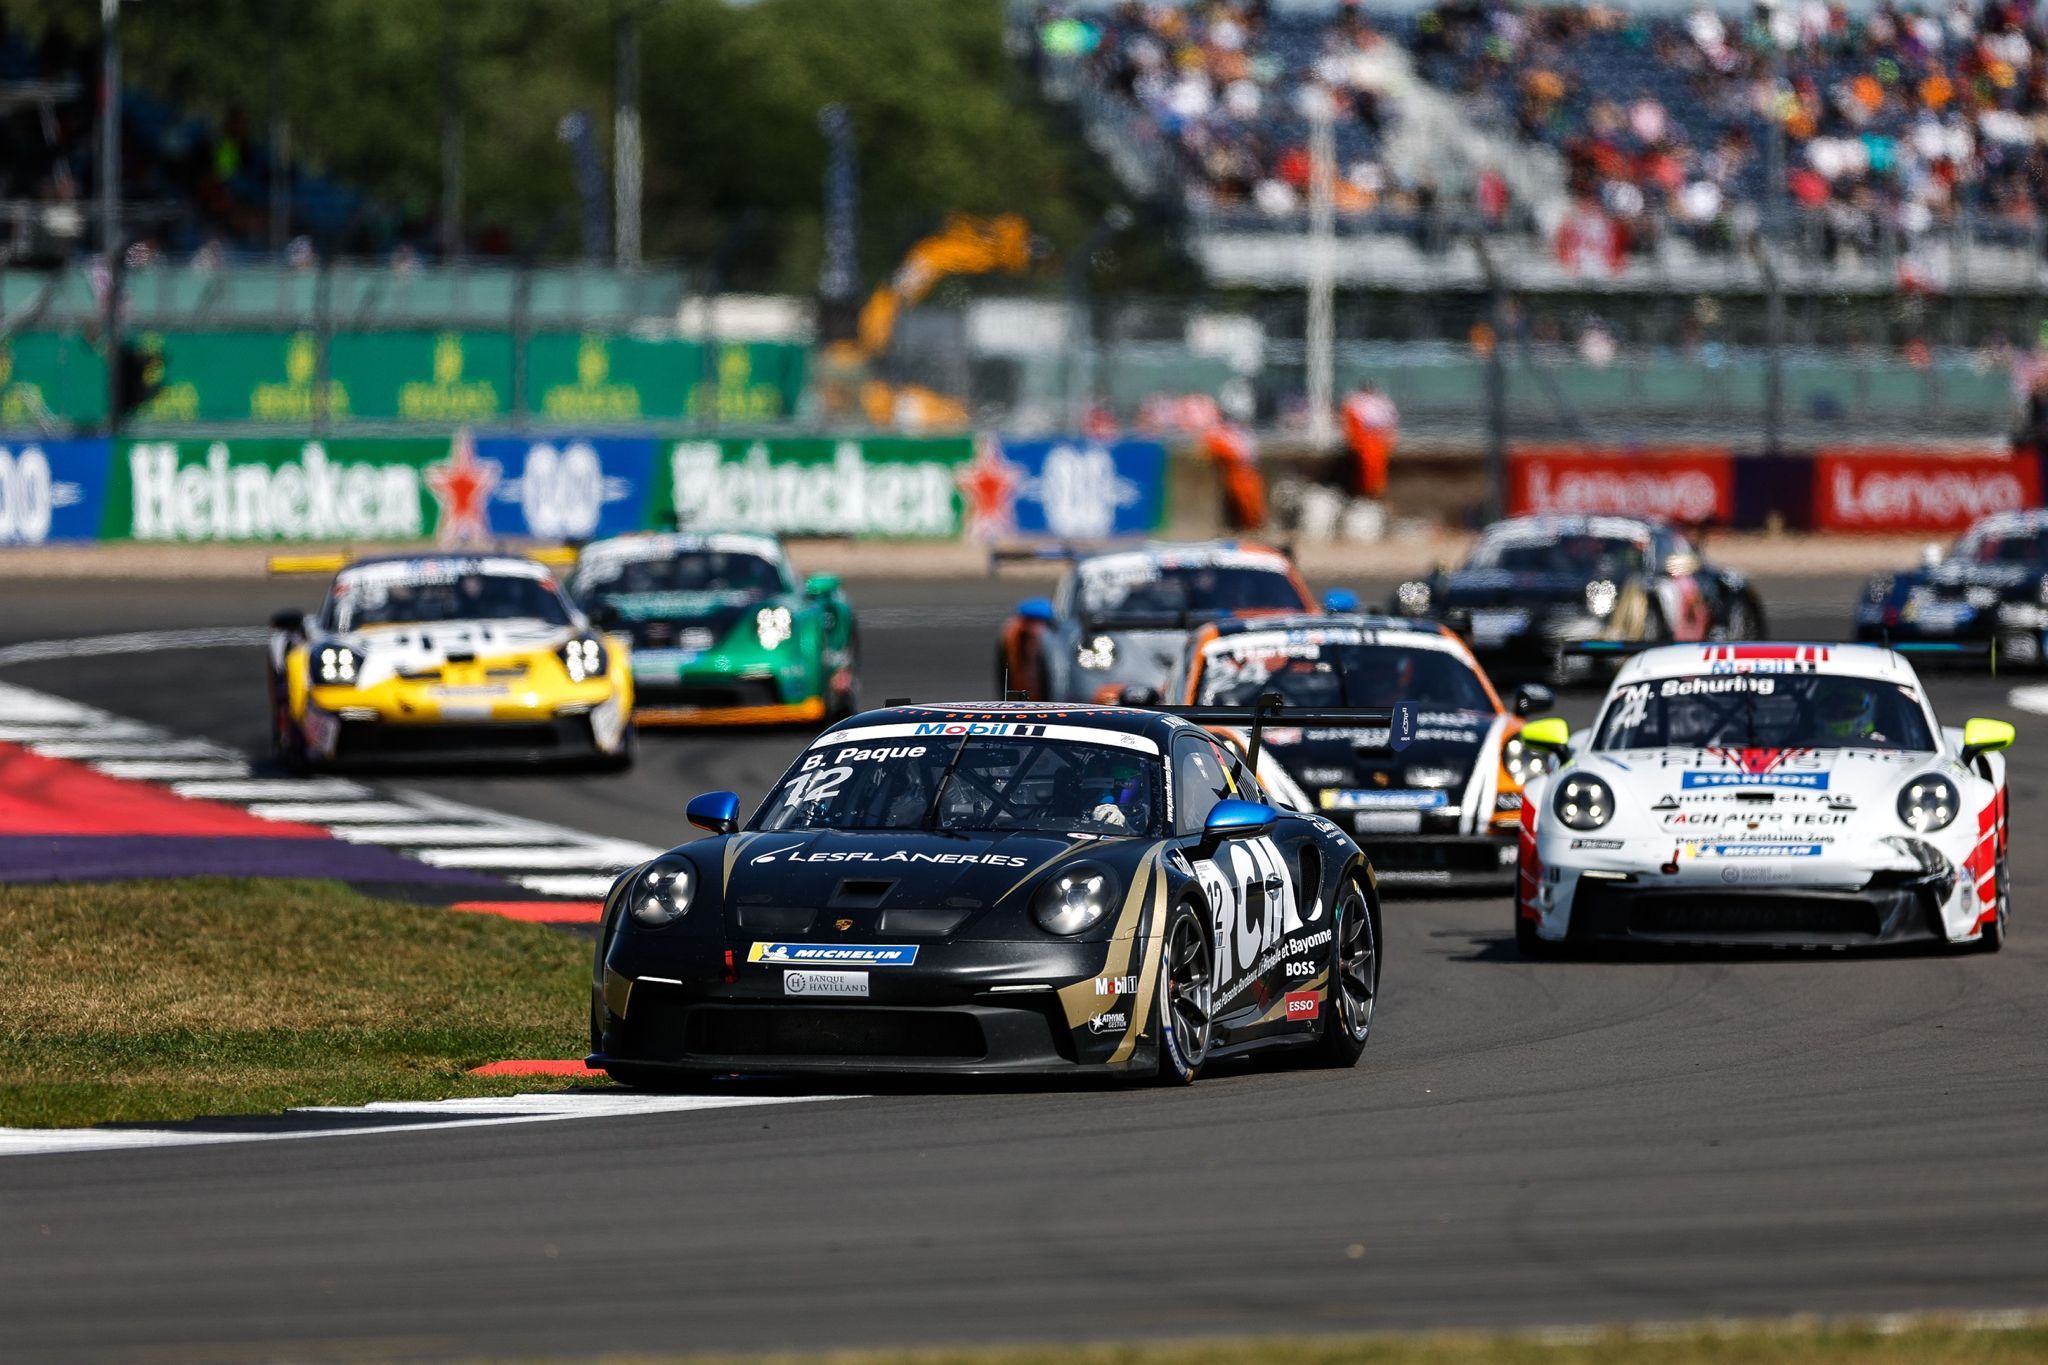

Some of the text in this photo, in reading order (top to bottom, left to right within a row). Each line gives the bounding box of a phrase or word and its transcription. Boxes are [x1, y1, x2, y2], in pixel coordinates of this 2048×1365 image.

[129, 441, 421, 539] Heineken
[671, 441, 957, 536] Heineken
[1527, 462, 1716, 519] Lenovo
[1832, 461, 2023, 519] Lenovo
[1624, 676, 1775, 703] M. Schuring
[914, 723, 1008, 736] Mobil
[800, 745, 927, 772] B. Paque
[784, 766, 853, 807] 12
[788, 850, 1028, 868] LESFLÂNERIES
[794, 949, 902, 960] MICHELIN
[1281, 945, 1290, 960] et
[1288, 929, 1332, 955] Bayonne
[808, 975, 845, 985] BANQUE
[1286, 961, 1316, 977] BOSS
[808, 983, 867, 993] HAVILLAND
[1095, 977, 1127, 995] Mobil
[1289, 1000, 1314, 1011] ESSO
